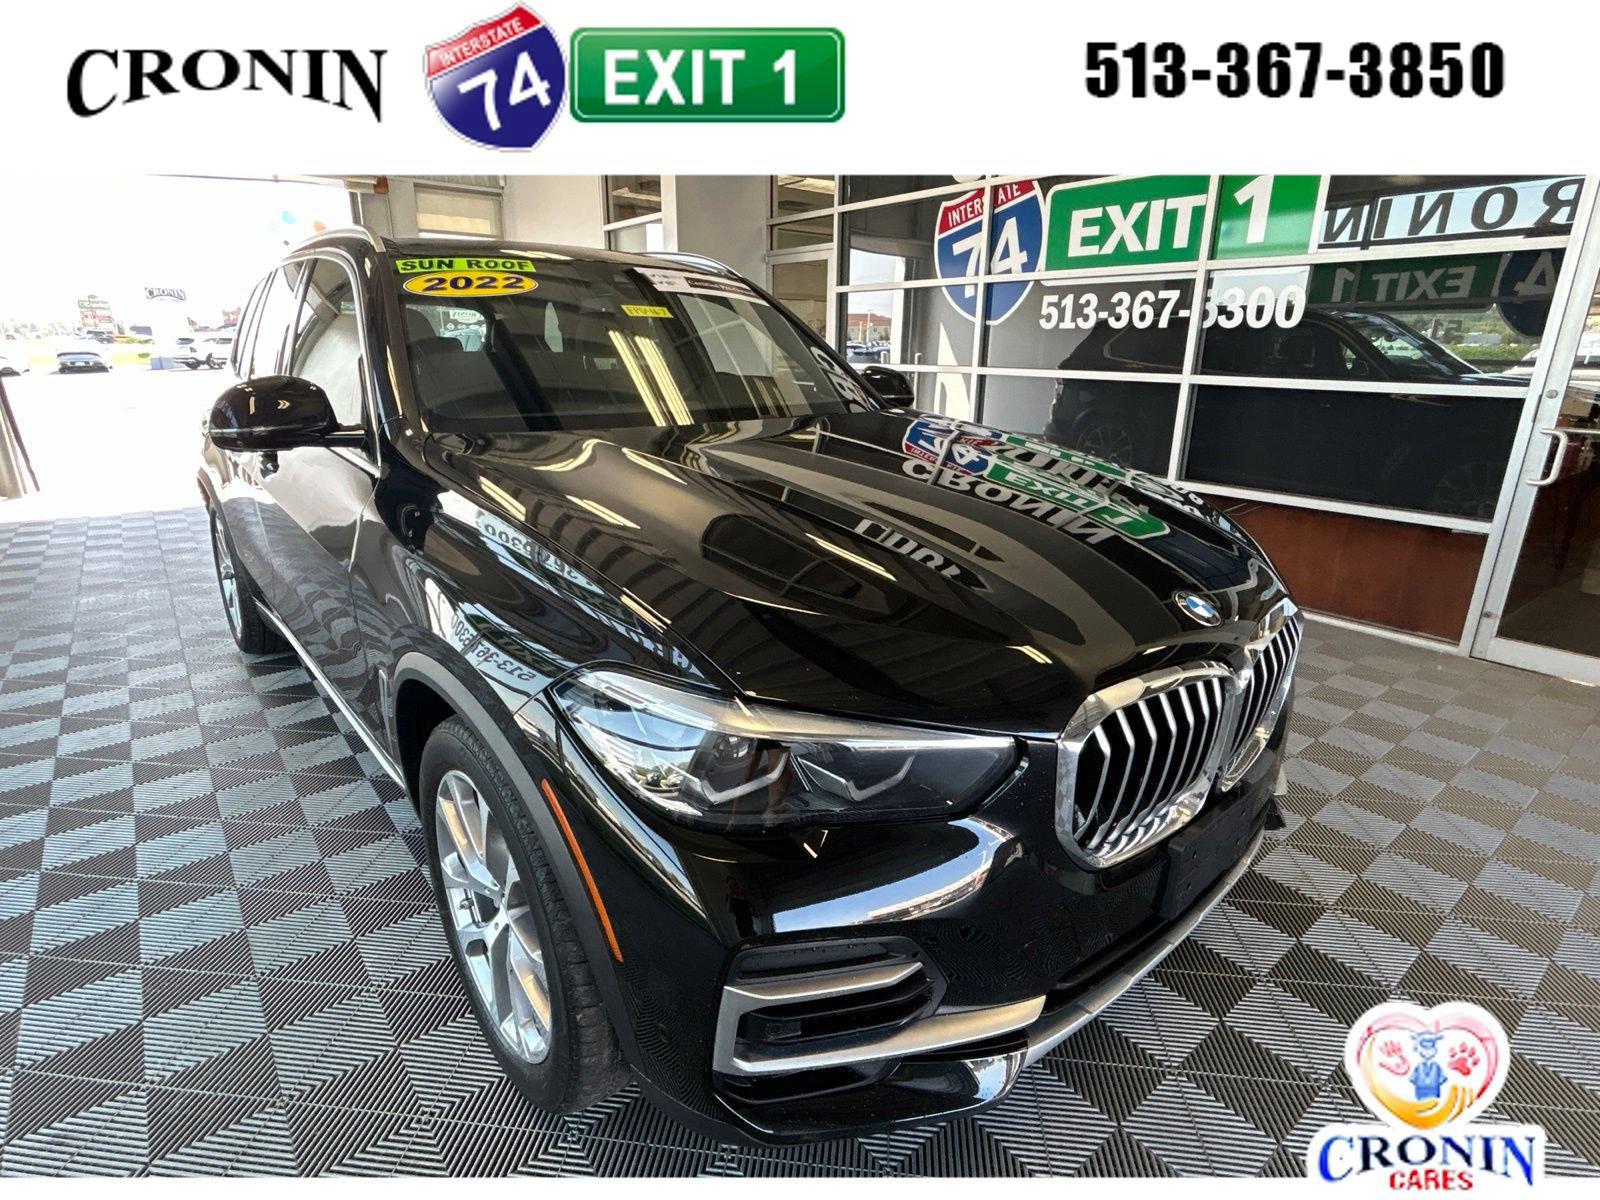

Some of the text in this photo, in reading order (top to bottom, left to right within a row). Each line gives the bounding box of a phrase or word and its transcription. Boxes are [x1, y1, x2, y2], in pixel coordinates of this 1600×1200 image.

[948, 183, 1021, 228] INTERATE
[1067, 174, 1274, 257] EXIT 1
[400, 259, 530, 271] SUN ROOF
[952, 217, 1028, 298] 74
[422, 276, 526, 292] 2022
